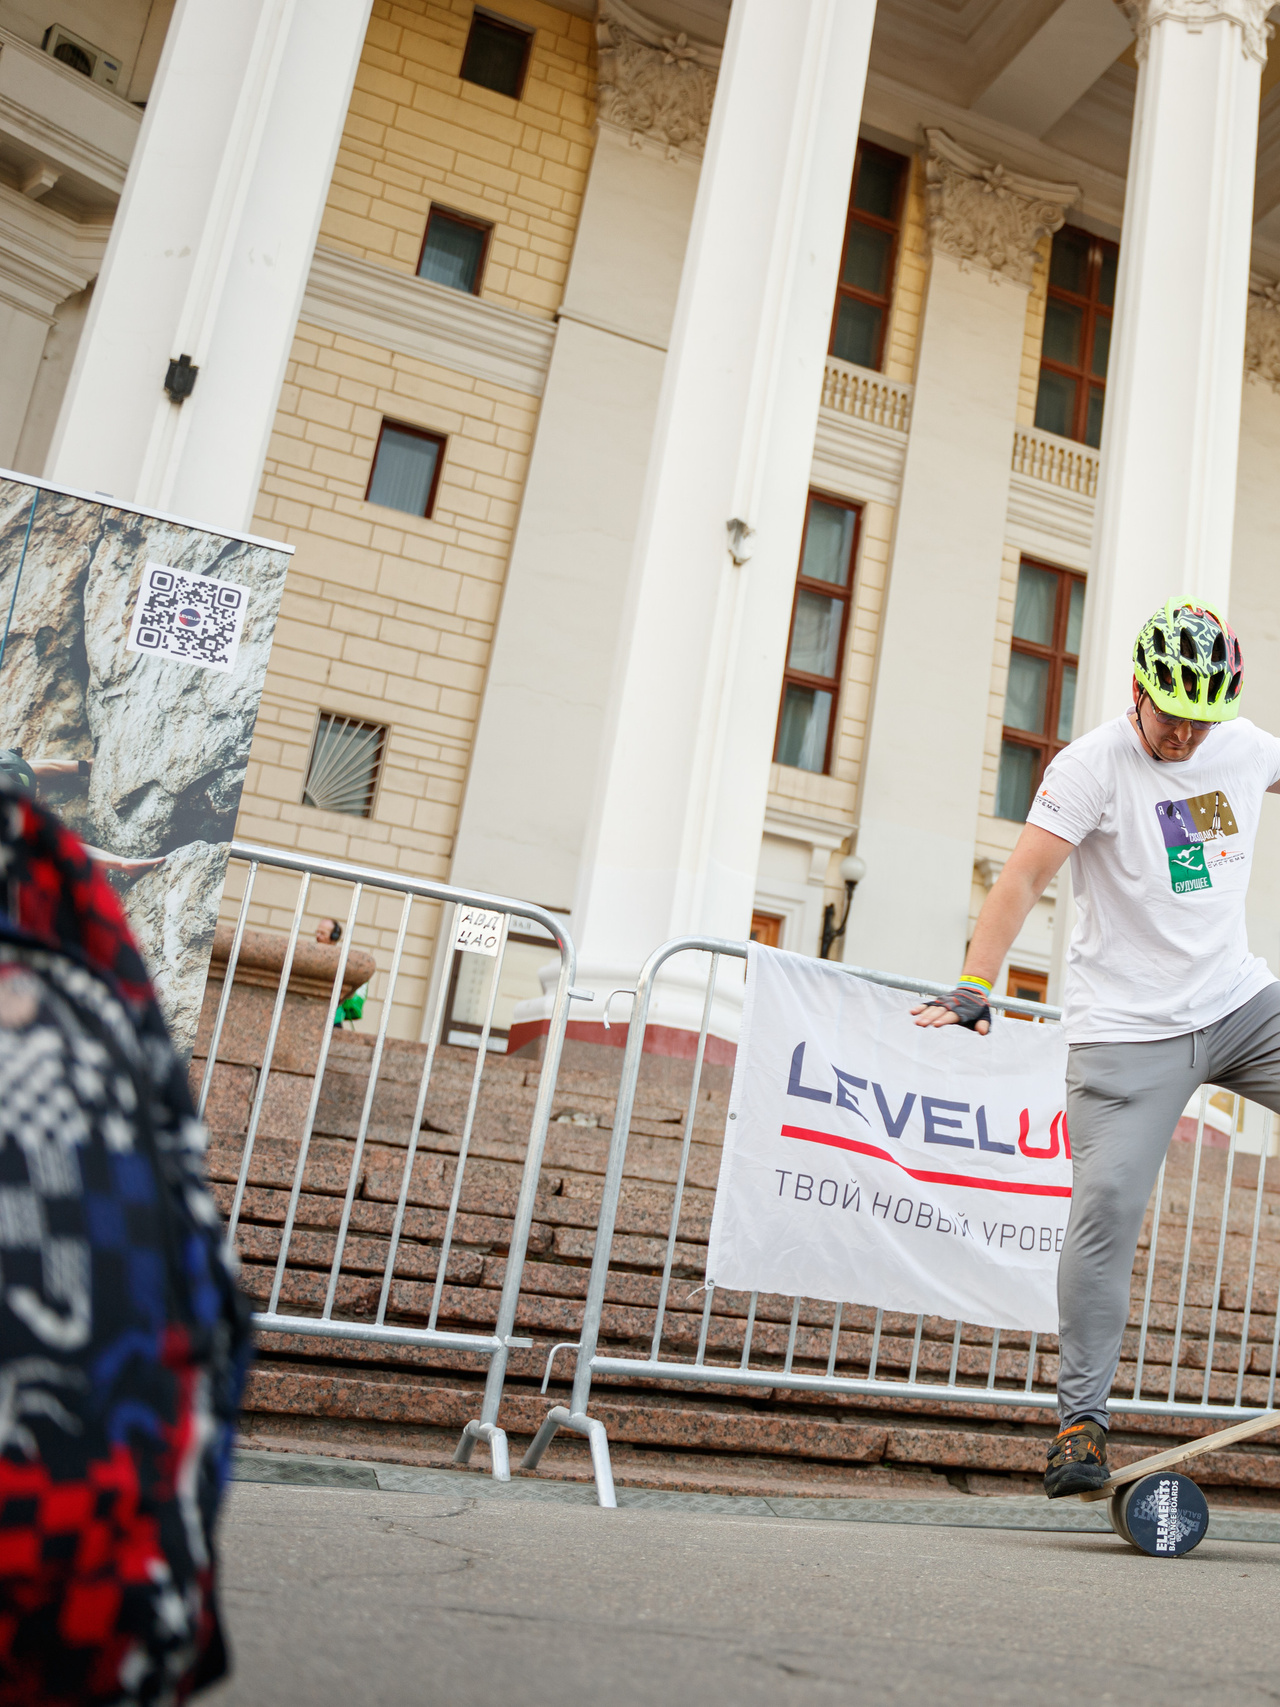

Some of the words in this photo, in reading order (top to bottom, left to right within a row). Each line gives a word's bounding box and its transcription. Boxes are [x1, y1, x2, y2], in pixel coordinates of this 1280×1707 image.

[1158, 805, 1165, 816] Я
[1208, 855, 1245, 869] СИСТЕМЫ
[1175, 876, 1210, 893] БУДУЩЕЕ
[461, 912, 500, 931] АВД
[457, 930, 497, 948] ЦАО
[786, 1041, 1073, 1160] LEVELU
[775, 1169, 862, 1212] ТВОЙ
[872, 1191, 974, 1240] НОВЫЙ
[1171, 1480, 1179, 1514] BOARDS
[1156, 1479, 1171, 1552] ELEMENTS
[1168, 1514, 1177, 1552] BALANCE
